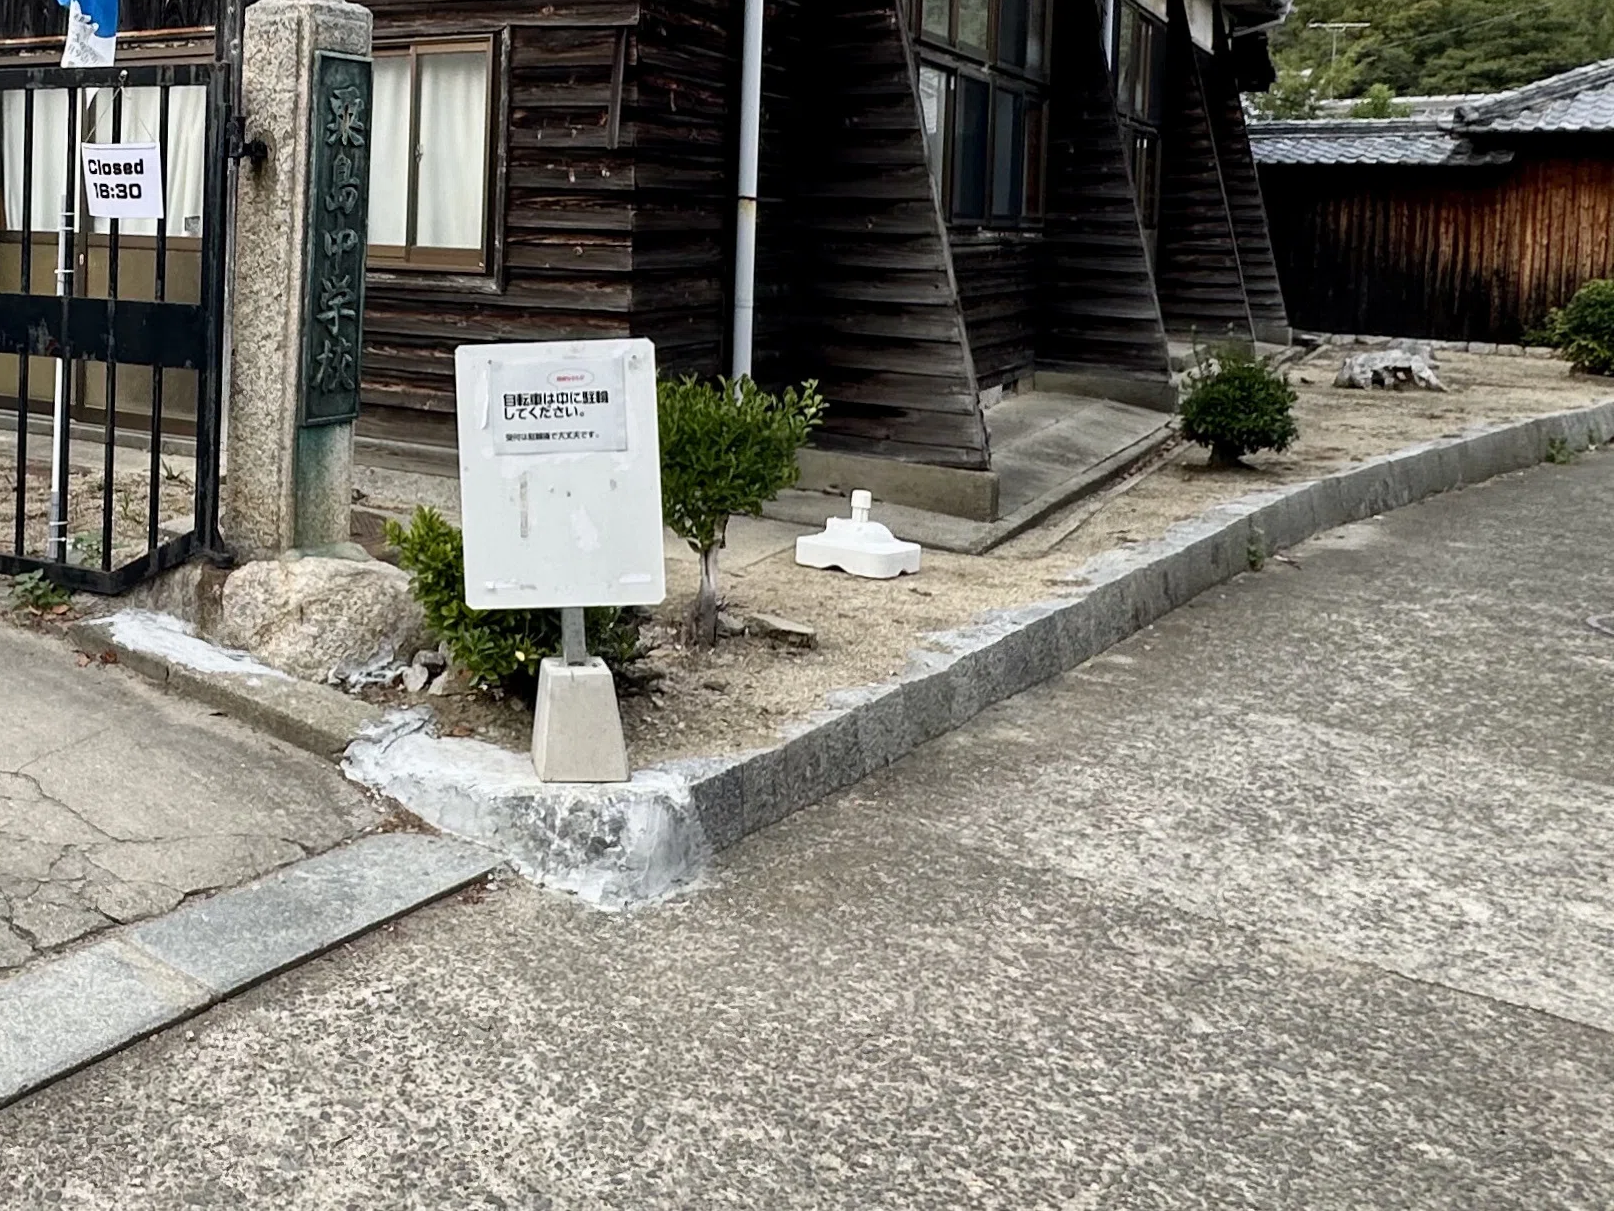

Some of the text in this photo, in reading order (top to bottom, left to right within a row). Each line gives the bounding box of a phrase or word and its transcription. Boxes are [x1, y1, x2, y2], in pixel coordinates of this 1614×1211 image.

[88, 158, 144, 176] Closed
[93, 182, 142, 199] 16:30
[312, 86, 365, 390] 粟島中学校
[503, 390, 609, 407] 自転車は中に駐輪
[504, 406, 584, 420] してください。
